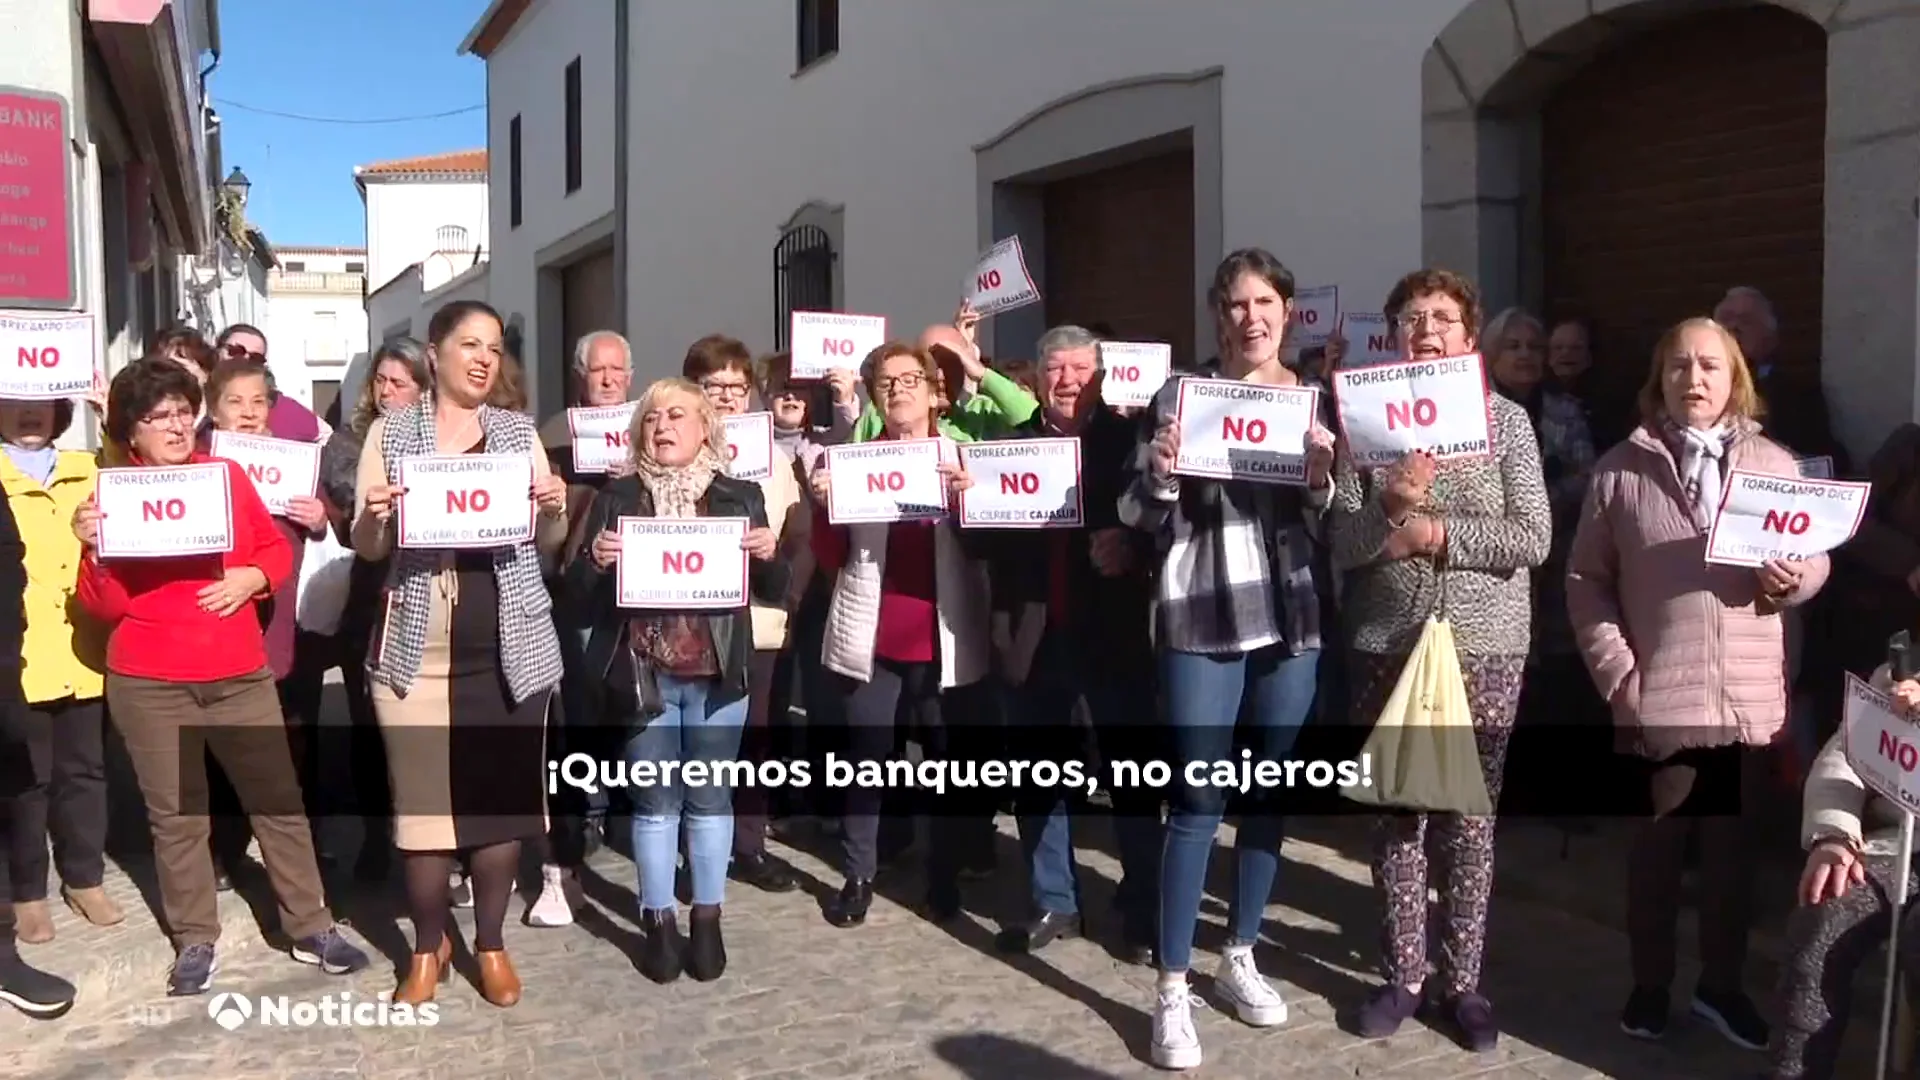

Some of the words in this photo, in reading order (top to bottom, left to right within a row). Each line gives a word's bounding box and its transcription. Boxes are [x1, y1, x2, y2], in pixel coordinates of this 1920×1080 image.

[977, 270, 1001, 292] NO
[18, 346, 60, 368] NO
[822, 337, 855, 356] NO
[1112, 365, 1140, 382] NO
[1344, 363, 1435, 386] TORRECAMPO
[1439, 359, 1469, 375] DICE
[1193, 385, 1273, 403] TORRECAMPO
[1277, 393, 1303, 406] DICE
[1386, 397, 1437, 431] NO
[1222, 416, 1267, 444] NO
[968, 446, 1039, 458] TORRECAMPO
[247, 463, 282, 485] NO
[413, 460, 493, 473] TORRECAMPO
[1251, 460, 1303, 476] CAJASUR
[109, 472, 187, 486] TORRECAMPO
[867, 471, 905, 493] NO
[1000, 472, 1039, 495] NO
[1742, 477, 1825, 497] TORRECAMPO
[142, 498, 186, 522] NO
[446, 489, 490, 514] NO
[477, 525, 528, 538] CAJASUR
[632, 524, 707, 535] TORRECAMPO
[1762, 508, 1811, 536] NO
[662, 550, 704, 574] NO
[692, 589, 741, 599] CAJASUR
[1878, 729, 1918, 772] NO
